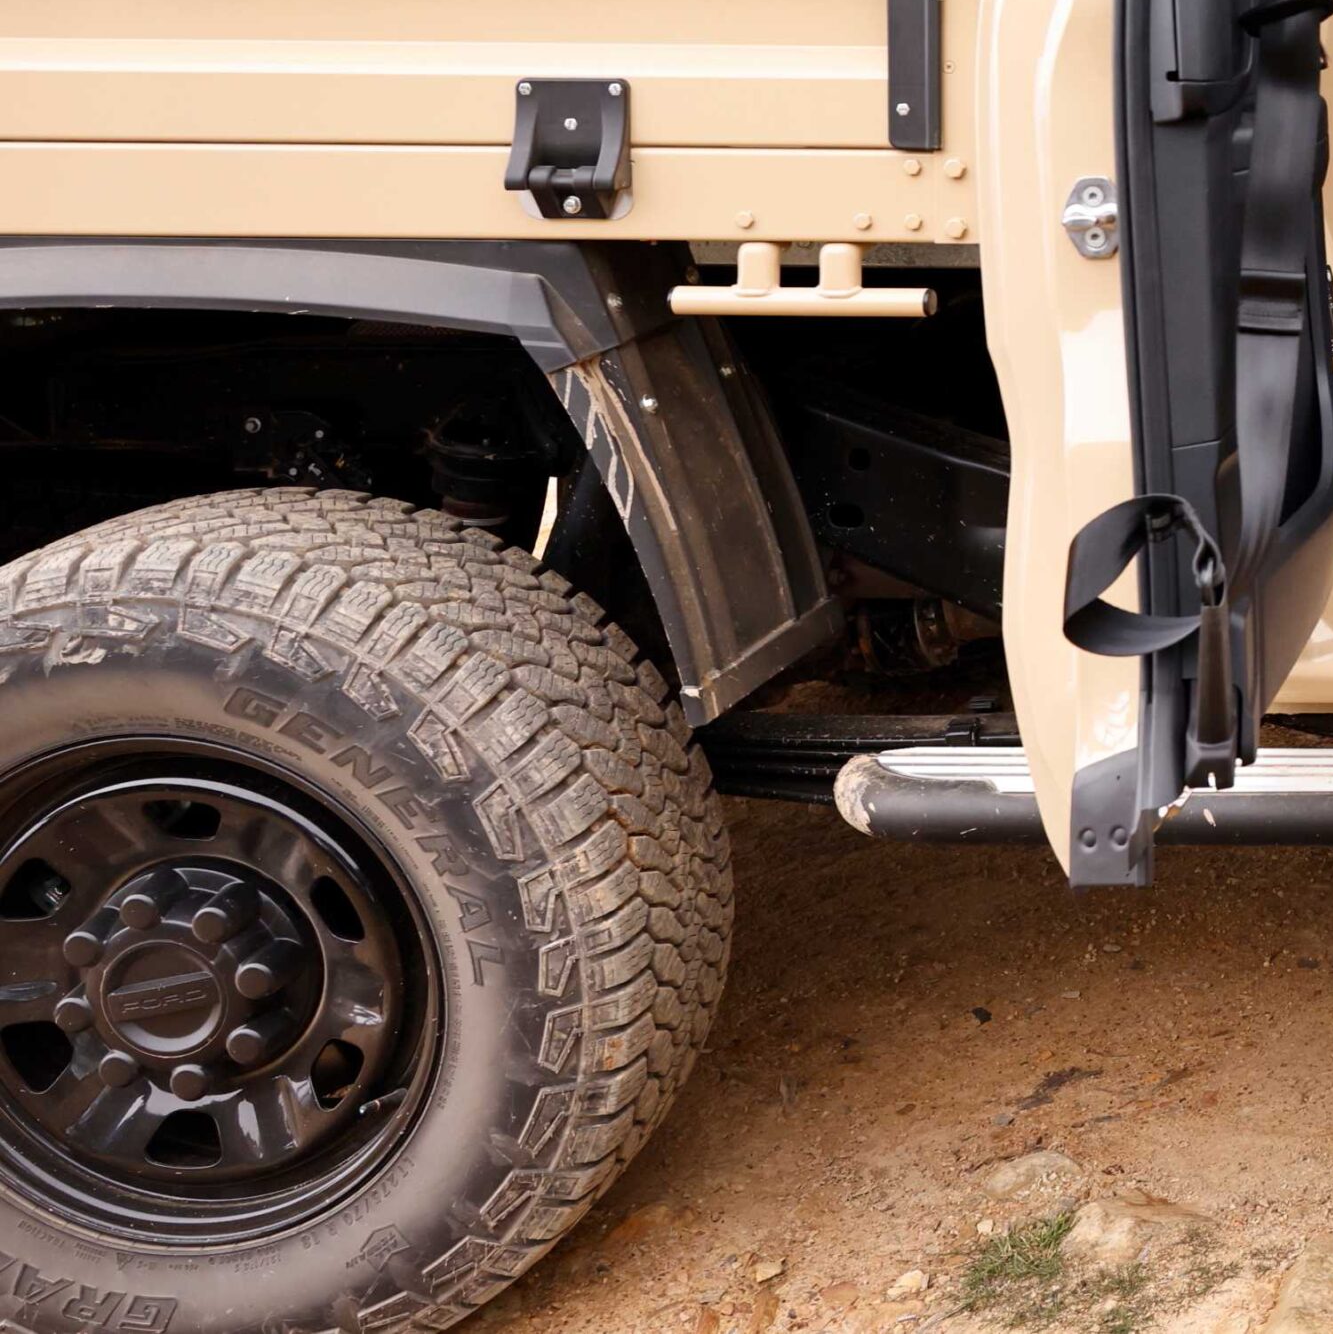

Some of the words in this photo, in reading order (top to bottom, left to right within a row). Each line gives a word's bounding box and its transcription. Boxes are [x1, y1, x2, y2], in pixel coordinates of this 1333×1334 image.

[223, 686, 504, 986] GENERAL
[121, 989, 208, 1014] FORD
[0, 1250, 177, 1334] GRA
